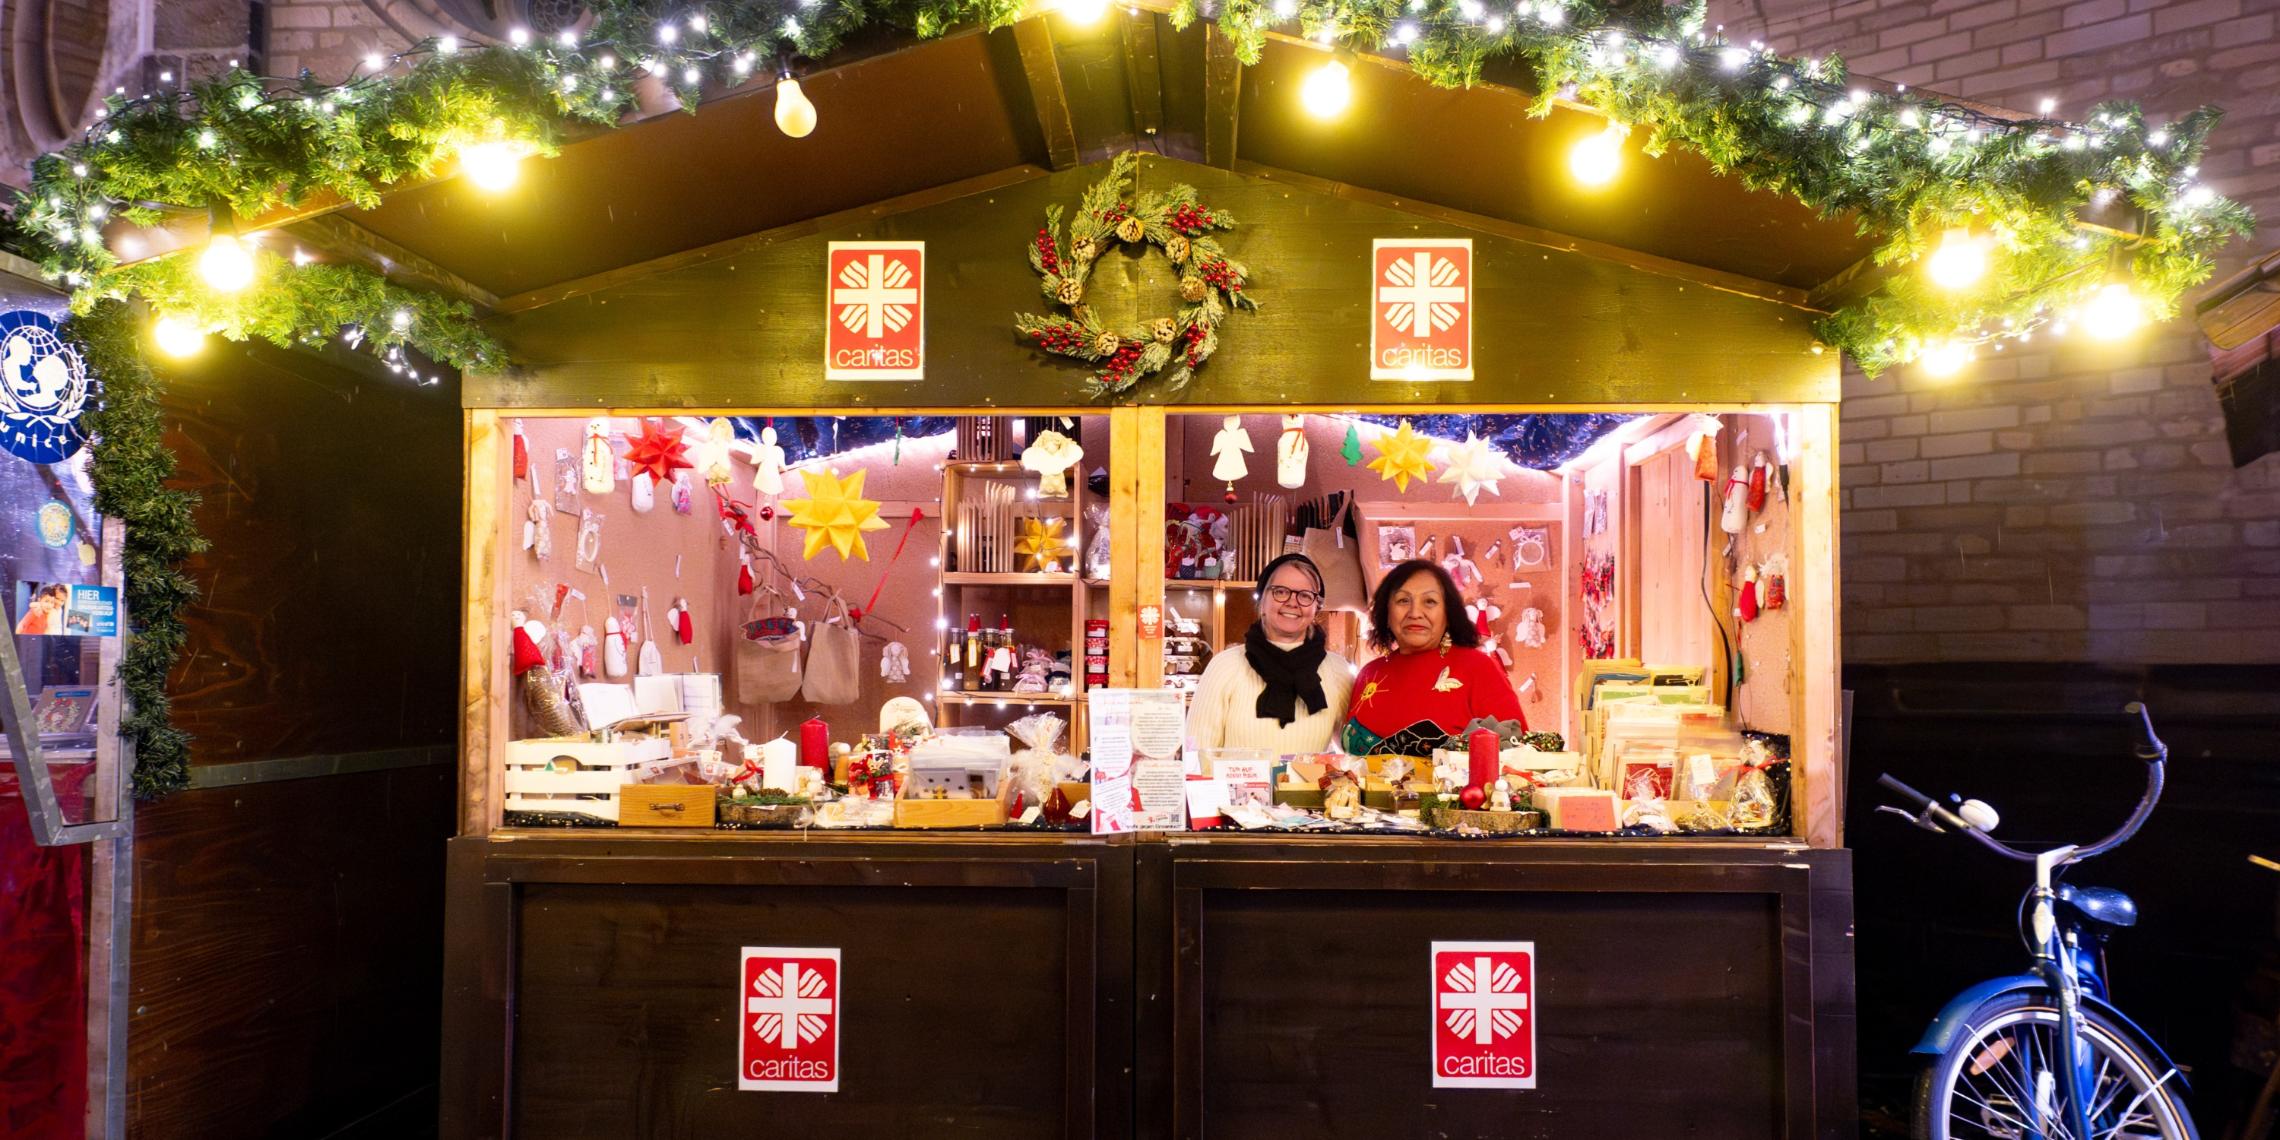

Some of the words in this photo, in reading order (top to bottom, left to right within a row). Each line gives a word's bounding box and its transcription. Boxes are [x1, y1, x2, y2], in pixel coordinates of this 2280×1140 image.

[836, 343, 914, 367] caritas
[1382, 343, 1462, 367] caritas
[0, 421, 74, 448] unice
[78, 589, 100, 600] HIER
[750, 1054, 828, 1079] caritas
[1444, 1050, 1525, 1075] caritas
